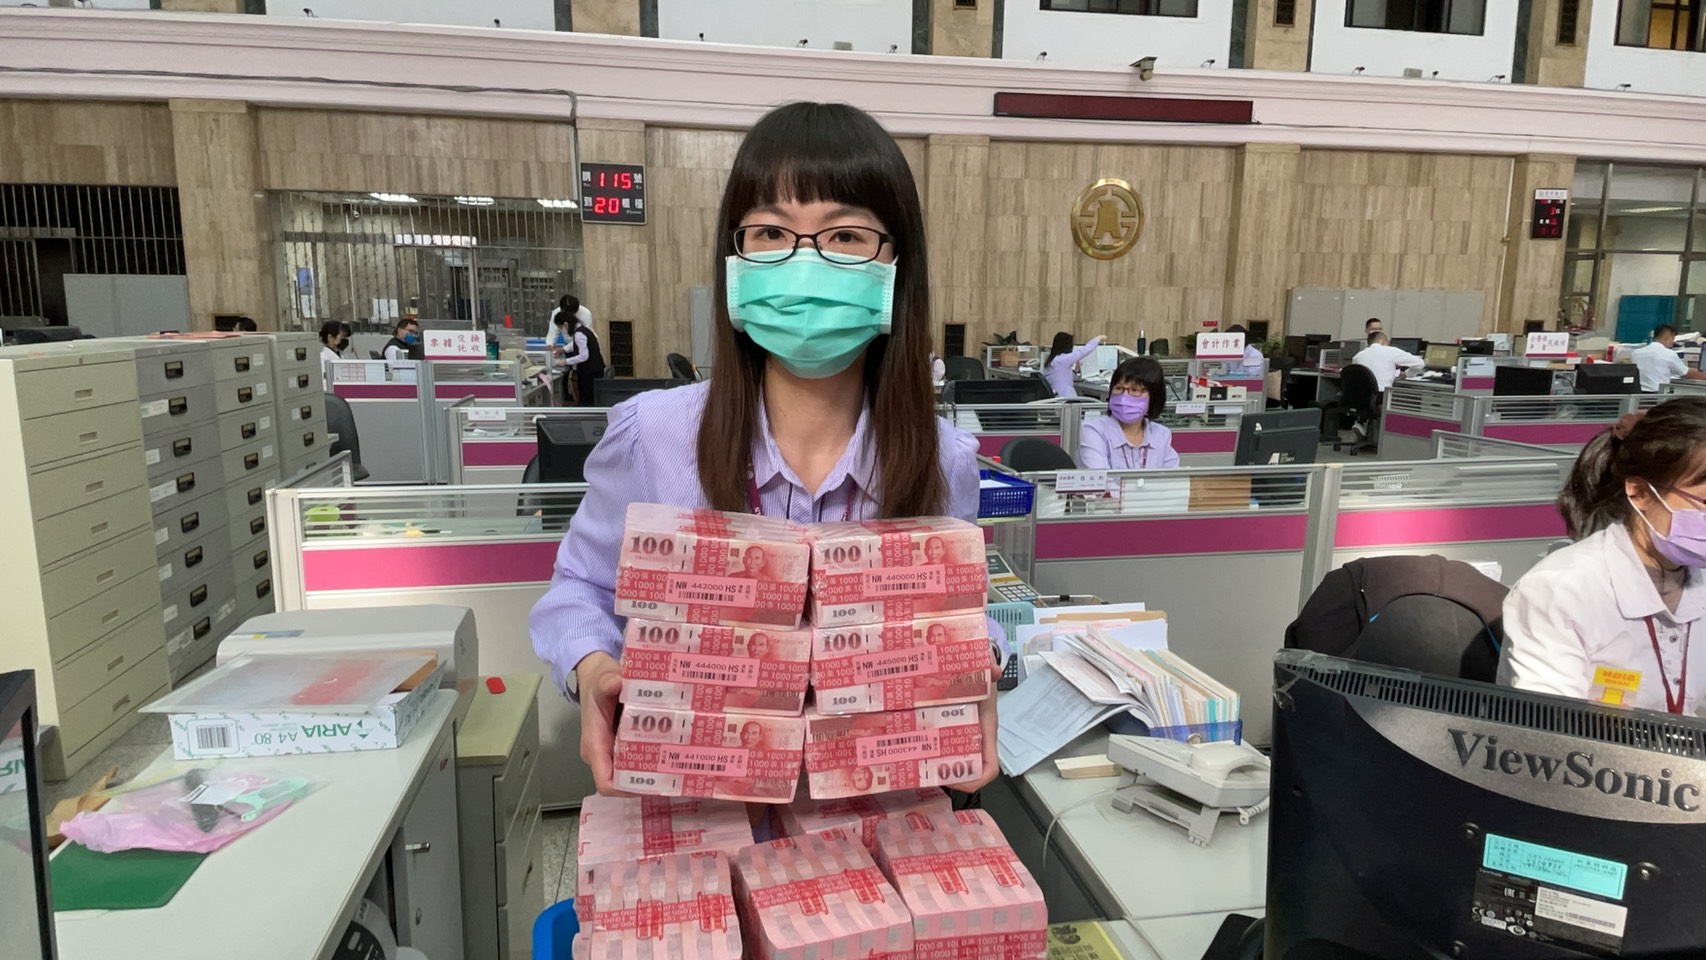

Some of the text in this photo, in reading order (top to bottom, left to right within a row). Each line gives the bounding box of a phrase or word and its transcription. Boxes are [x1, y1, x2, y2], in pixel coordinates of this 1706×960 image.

[600, 172, 632, 189] 115
[594, 196, 619, 214] 20
[1202, 338, 1240, 349] 會計作業
[631, 536, 674, 556] 100
[823, 545, 862, 564] 100
[872, 575, 882, 583] NW
[917, 572, 928, 580] HS
[675, 581, 688, 589] NW
[691, 582, 724, 591] 442000
[725, 585, 736, 593] HS
[631, 600, 658, 610] 100
[832, 608, 857, 618] 100
[636, 626, 679, 644] 100
[822, 632, 862, 652] 100
[680, 660, 691, 668] NW
[695, 662, 727, 670] 444000
[728, 664, 739, 673] HS
[862, 661, 873, 670] NW
[877, 656, 907, 666] 445000
[908, 654, 919, 663] HS
[636, 688, 663, 698] 100
[832, 696, 857, 706] 100
[941, 708, 965, 718] 100
[630, 714, 673, 733] 100
[300, 722, 352, 738] ARIA
[254, 733, 272, 745] 80
[279, 731, 297, 744] A4
[876, 748, 887, 757] HS
[888, 746, 917, 755] 443000
[668, 752, 681, 760] NW
[717, 755, 728, 763] HS
[938, 760, 975, 780] 100
[1448, 729, 1700, 812] ViewSonic
[629, 776, 656, 786] 100
